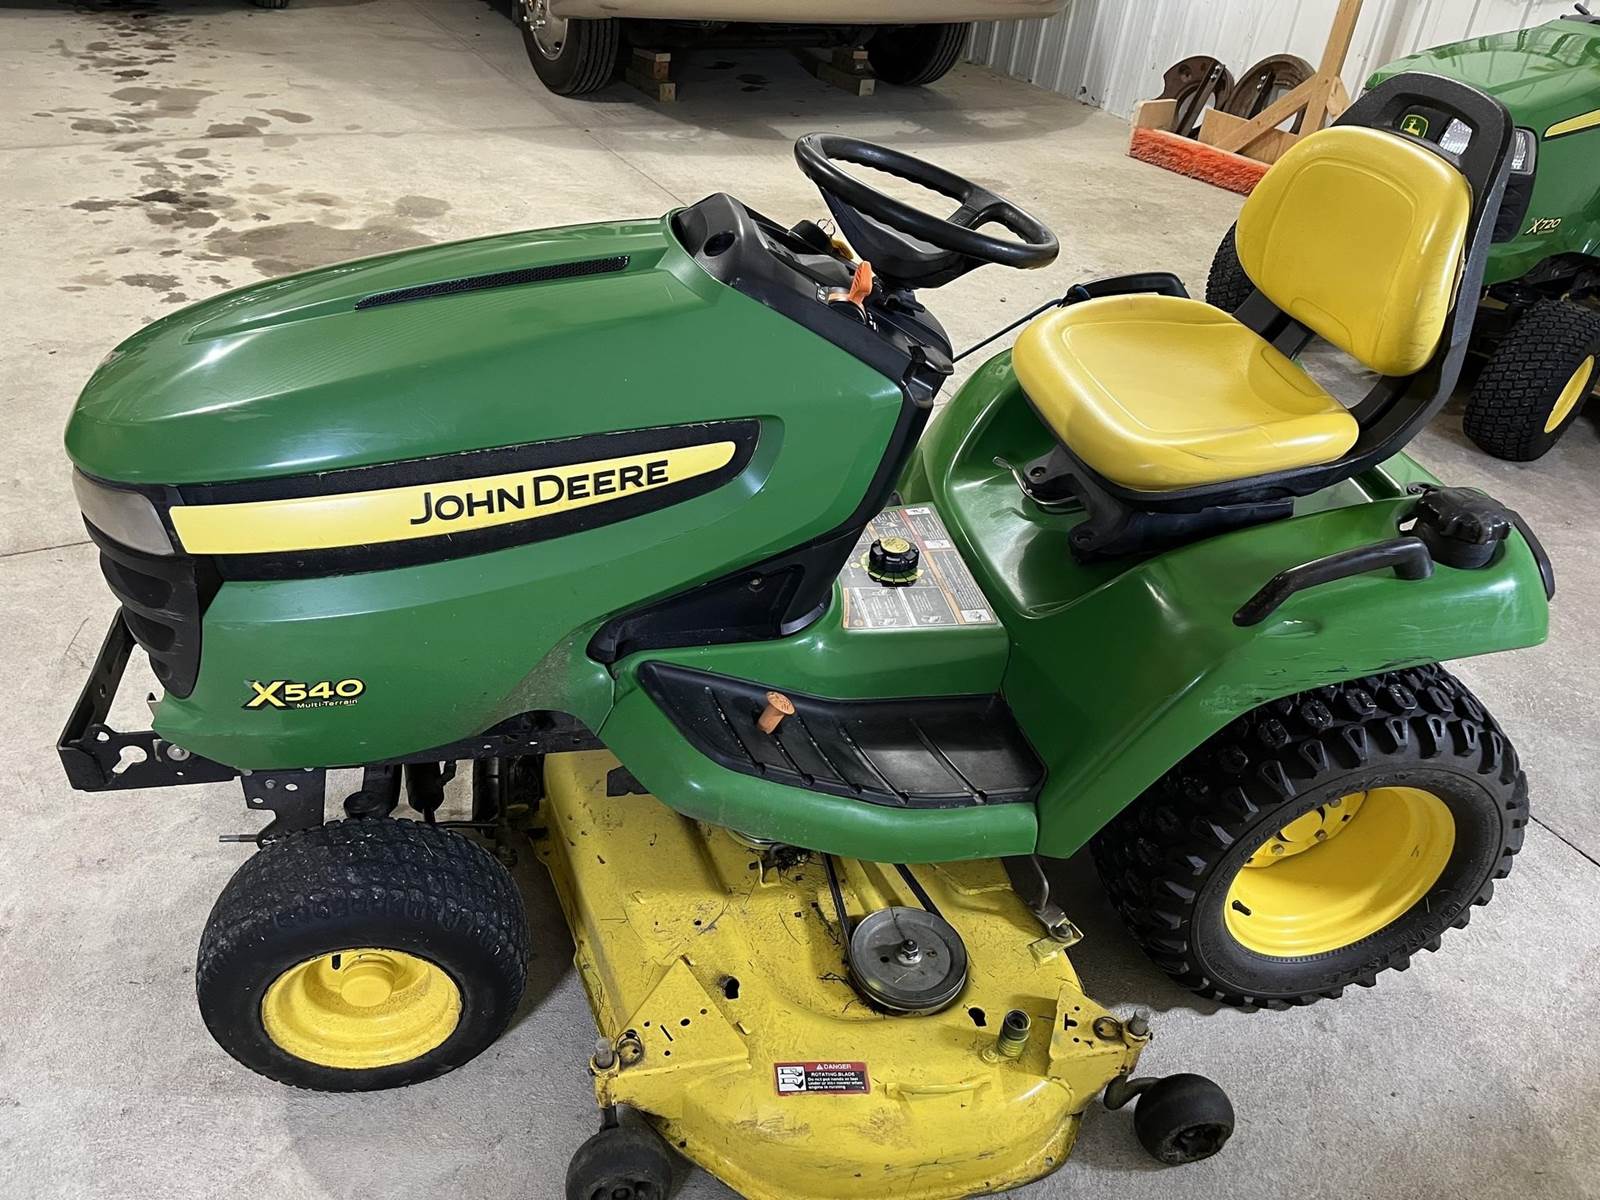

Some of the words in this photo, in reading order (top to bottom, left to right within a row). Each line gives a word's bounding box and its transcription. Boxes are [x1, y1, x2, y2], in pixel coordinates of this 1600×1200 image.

[1525, 218, 1562, 233] X720
[410, 485, 525, 525] JOHN
[533, 459, 669, 507] DEERE
[244, 678, 364, 708] X540
[296, 699, 358, 709] Multi-Terrain
